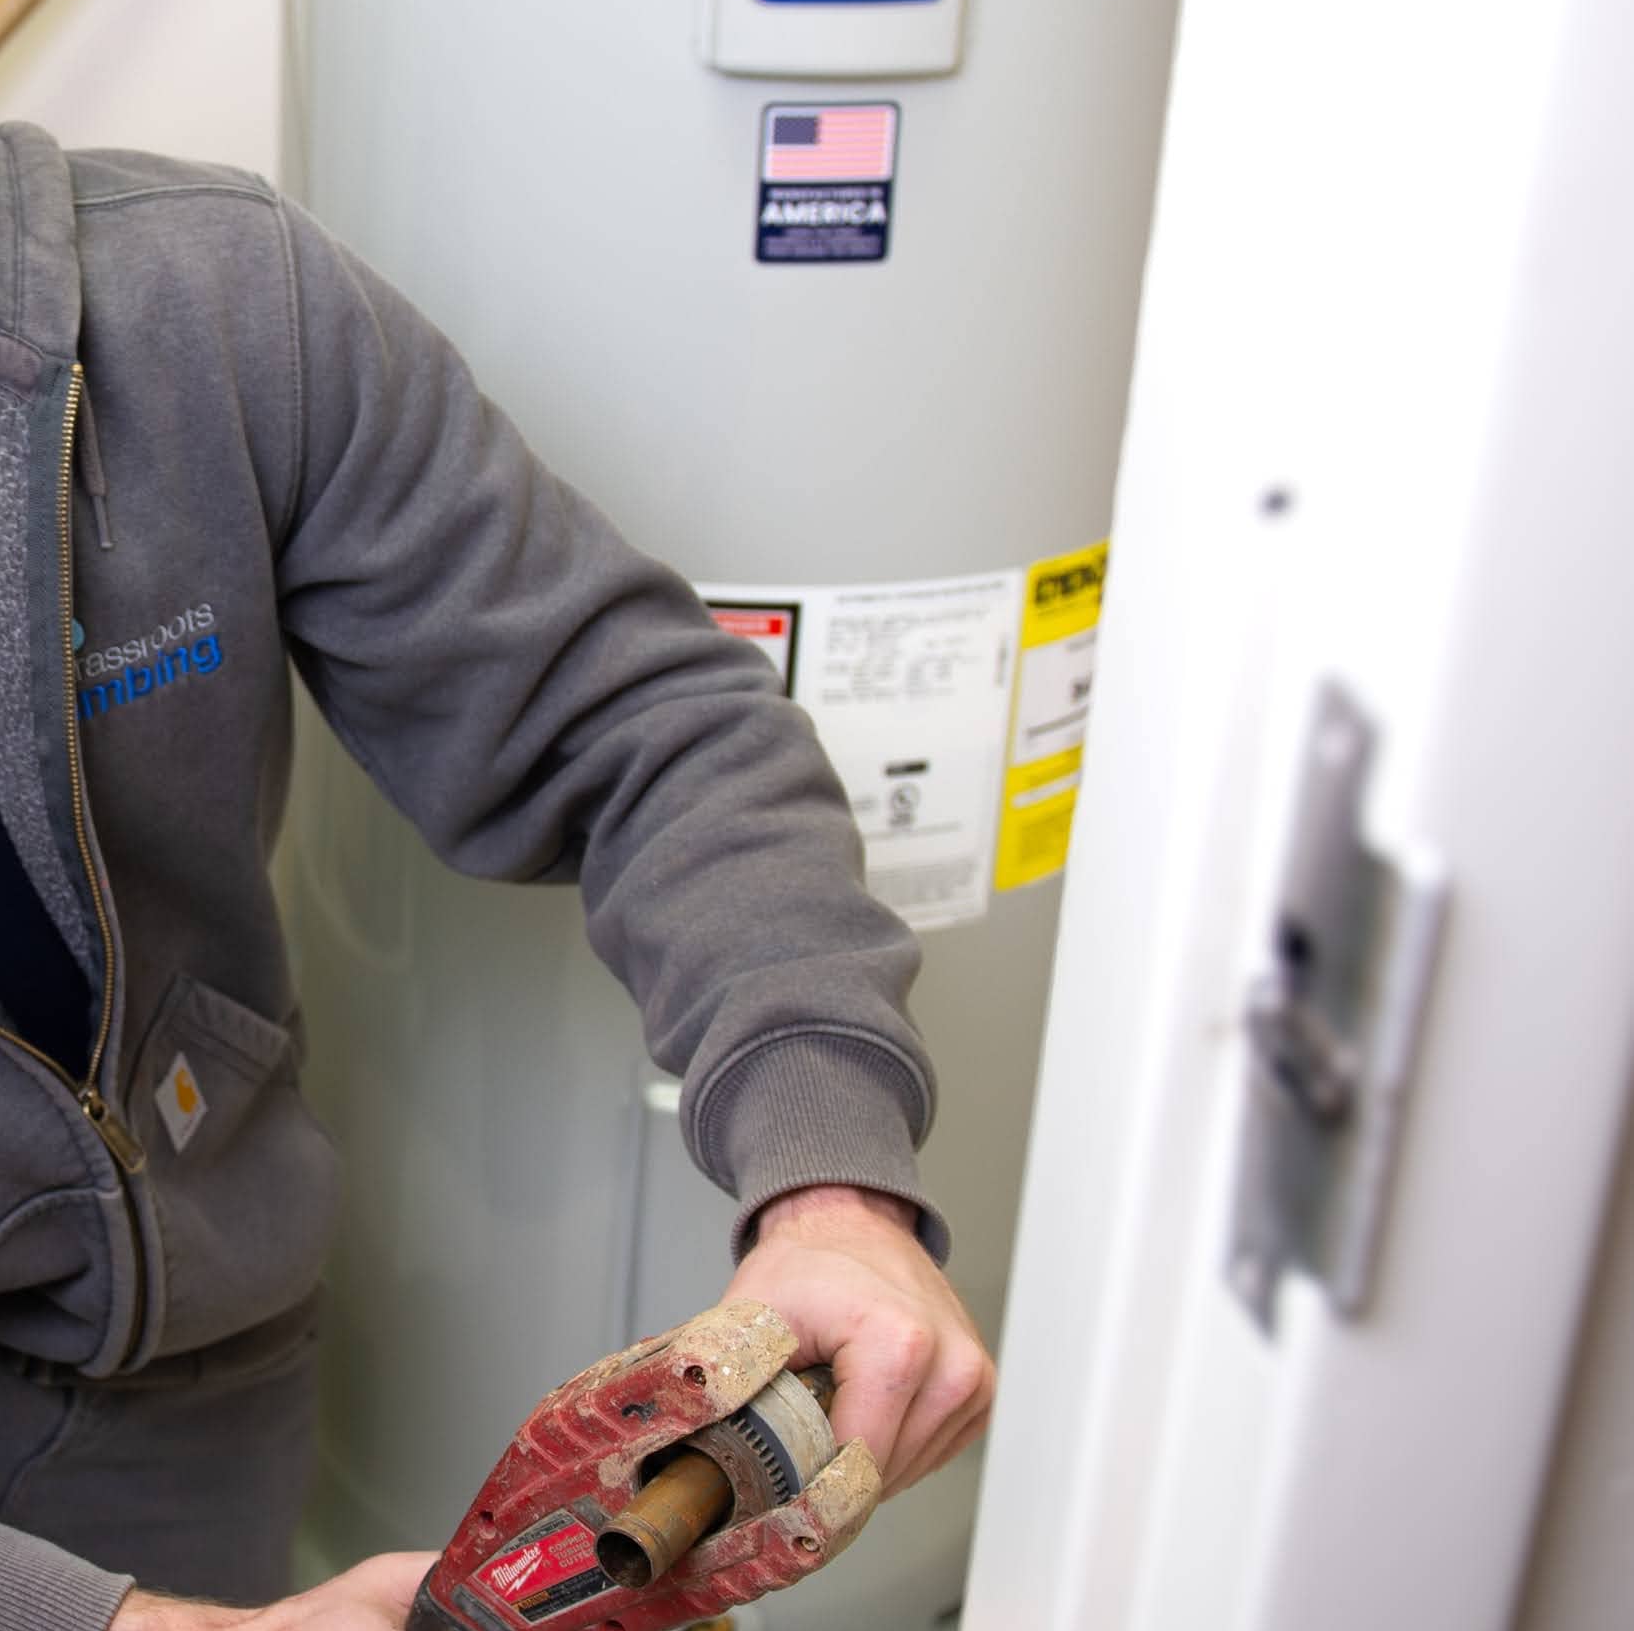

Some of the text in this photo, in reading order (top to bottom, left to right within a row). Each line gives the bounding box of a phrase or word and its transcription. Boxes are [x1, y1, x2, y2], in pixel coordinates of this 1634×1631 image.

[761, 200, 887, 226] AMERICA
[76, 635, 224, 721] mbing
[491, 1544, 542, 1590] Milwaukee
